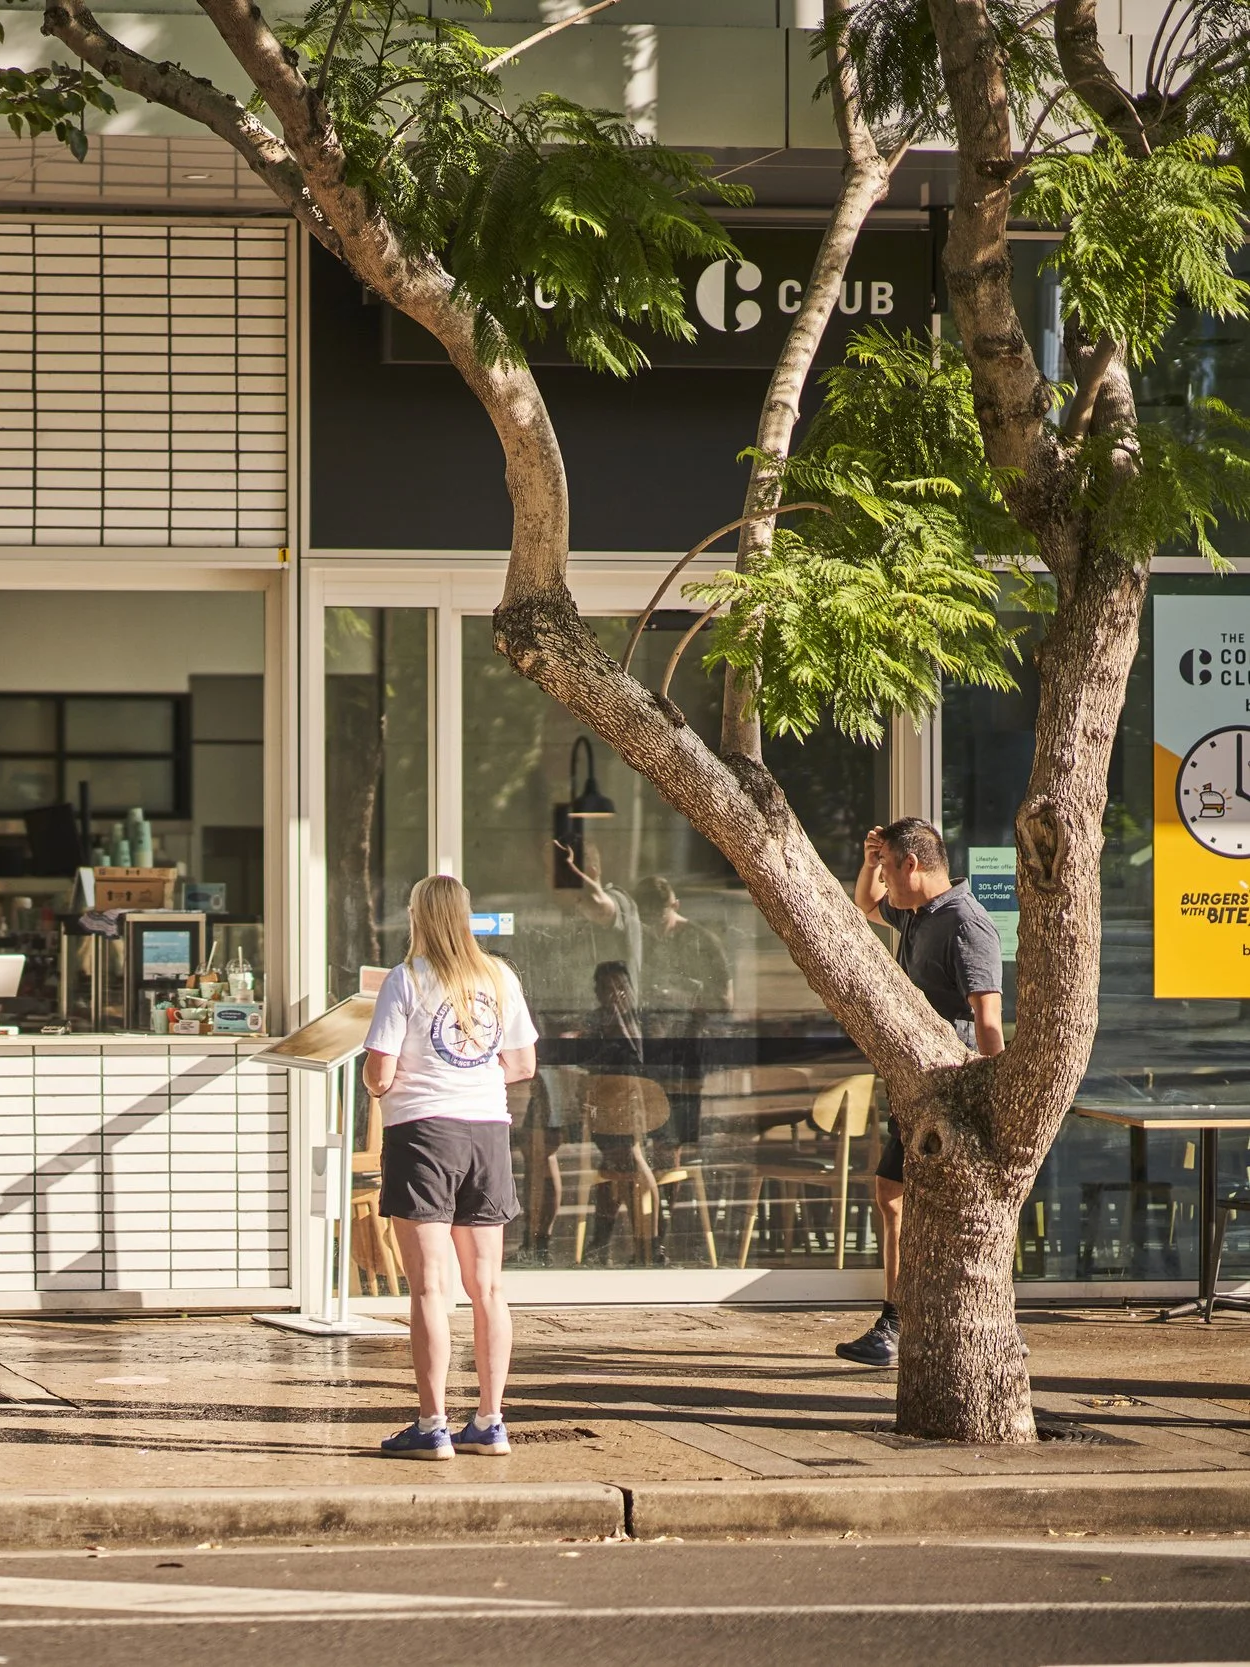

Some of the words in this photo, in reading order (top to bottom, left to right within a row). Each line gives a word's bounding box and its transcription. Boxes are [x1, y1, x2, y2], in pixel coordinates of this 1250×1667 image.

[778, 279, 894, 315] CUB
[1221, 633, 1245, 643] THE
[1221, 670, 1250, 686] CL
[978, 883, 991, 891] 30%
[992, 882, 1003, 891] off
[978, 892, 1011, 901] purchase
[1181, 893, 1249, 906] BURGERS
[1181, 907, 1206, 916] WITH
[1207, 906, 1250, 924] BITE
